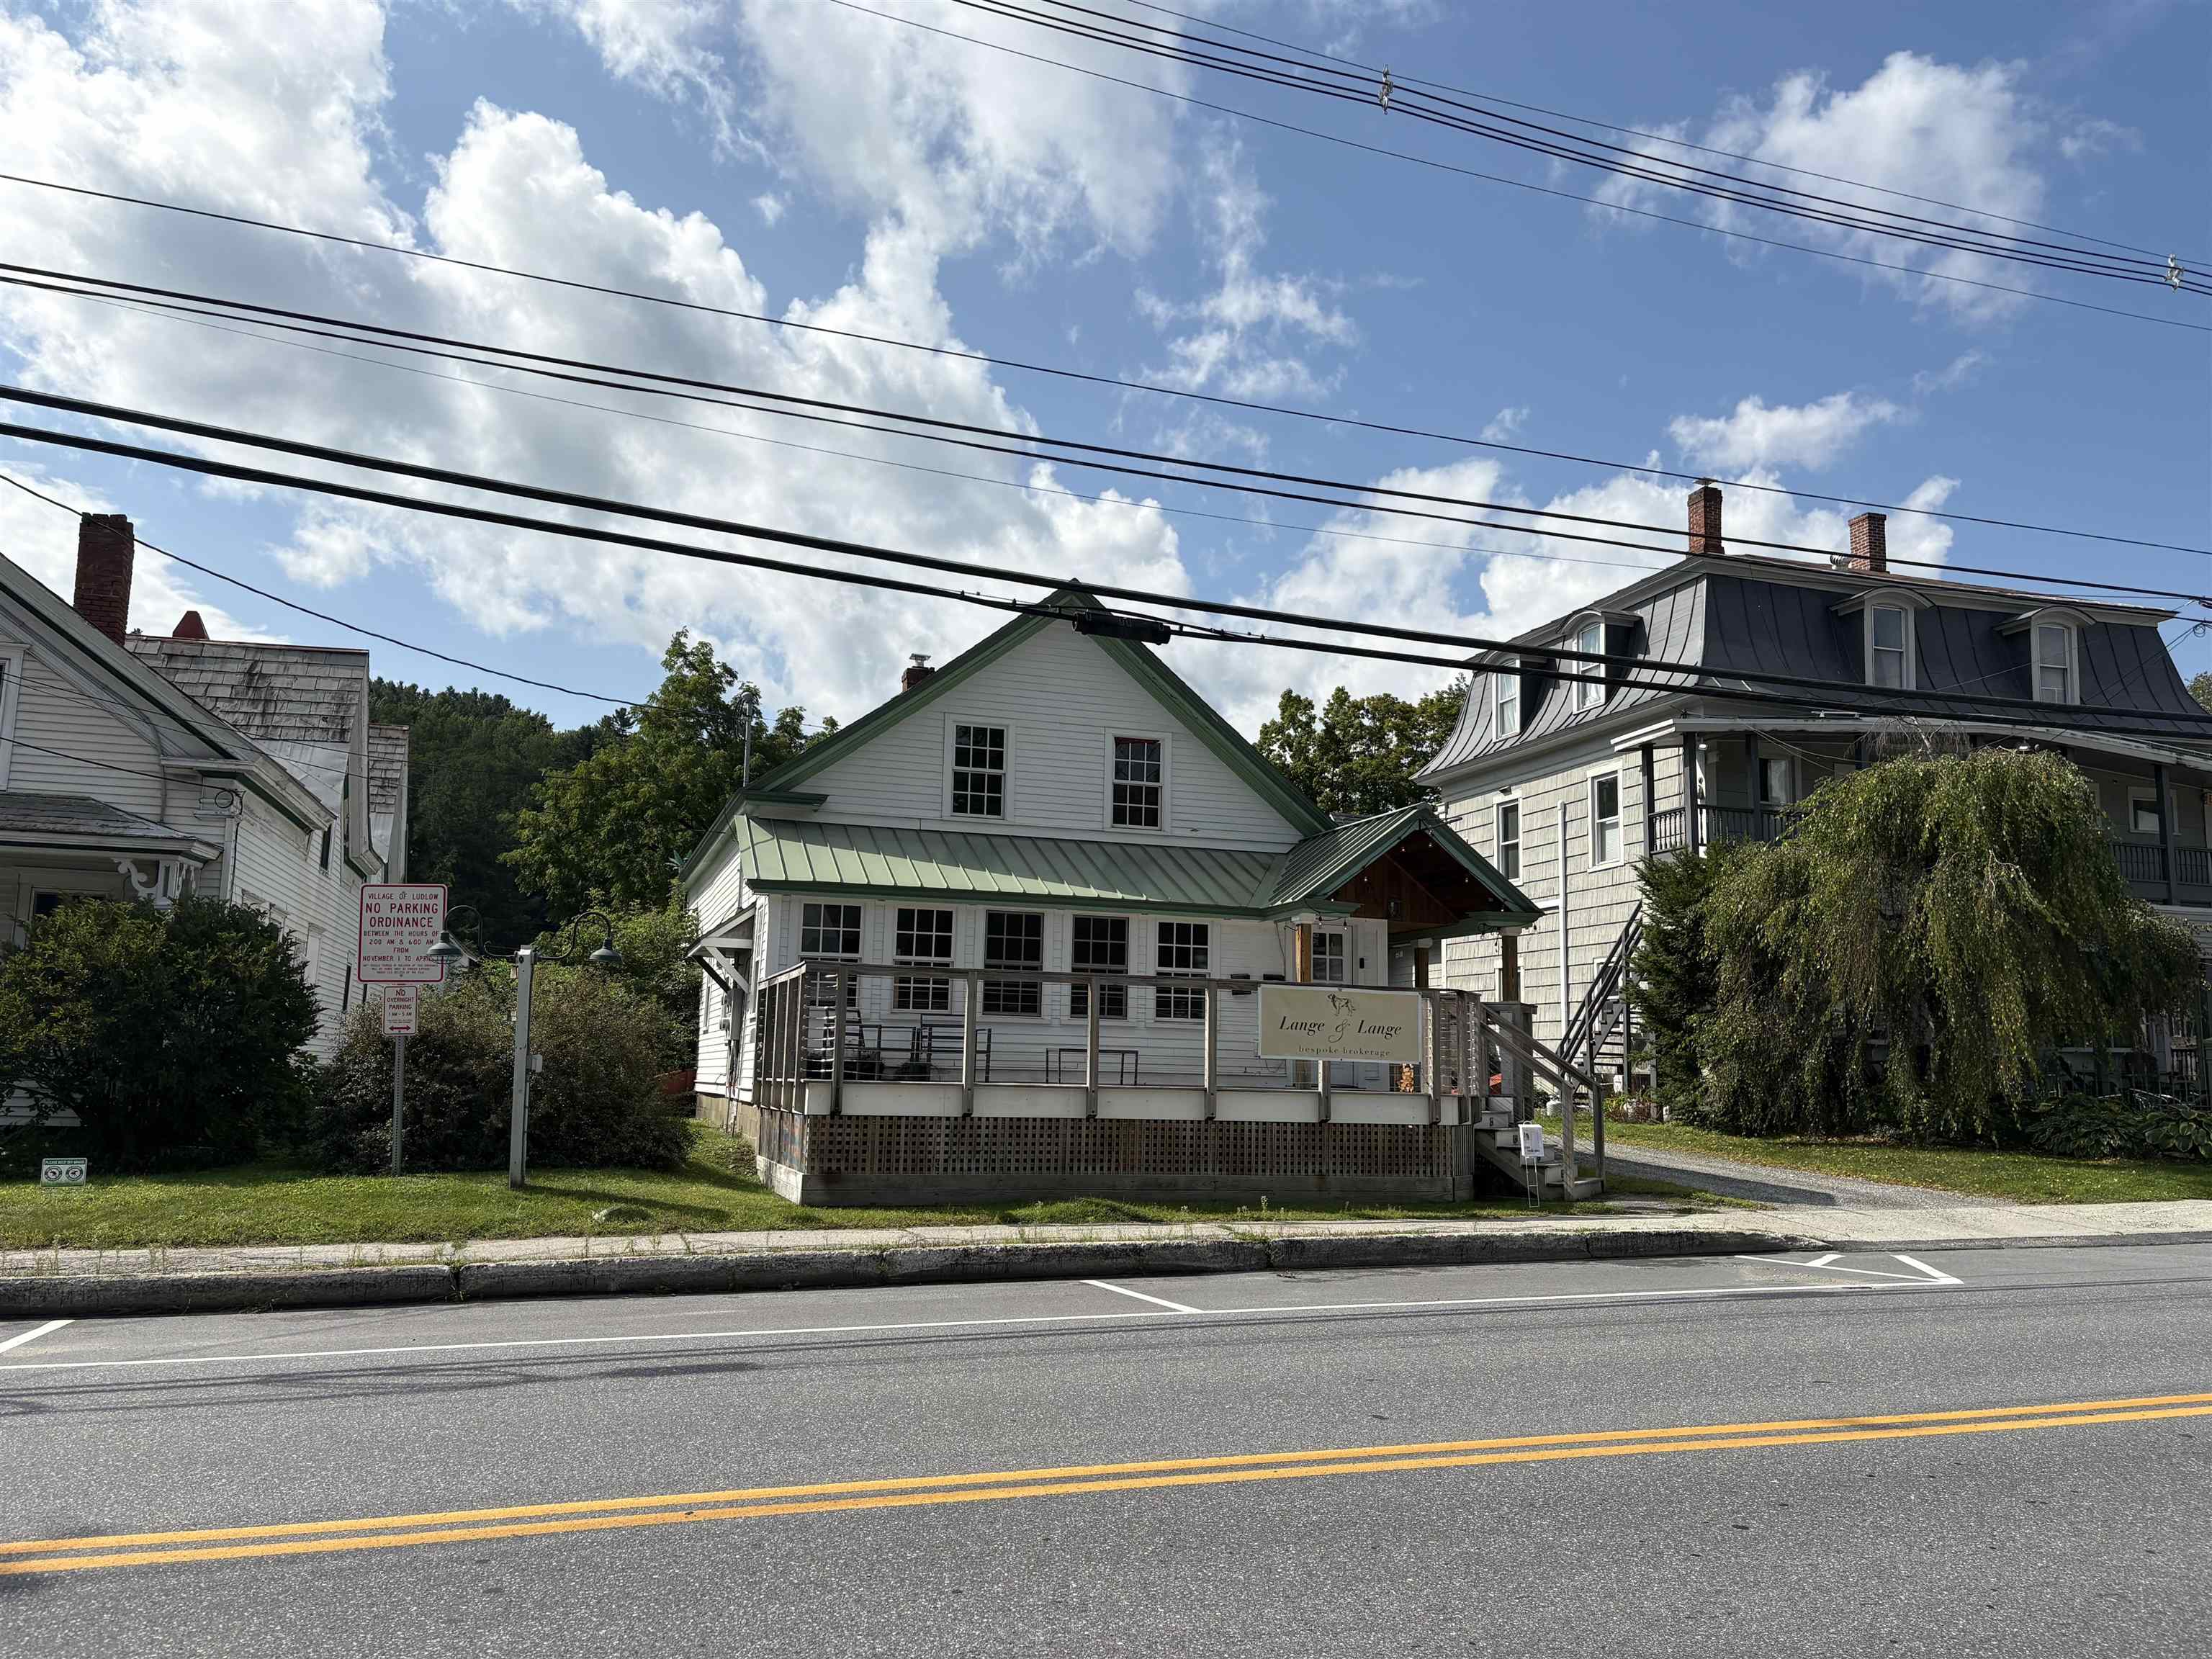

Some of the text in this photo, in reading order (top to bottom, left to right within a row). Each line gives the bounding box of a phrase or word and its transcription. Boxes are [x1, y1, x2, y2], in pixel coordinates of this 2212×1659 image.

[366, 902, 439, 914] NO PARKING
[369, 917, 433, 928] ORDINANCE
[1279, 1016, 1402, 1043] Lange & Lange
[1298, 1046, 1390, 1058] bespoke brokerage
